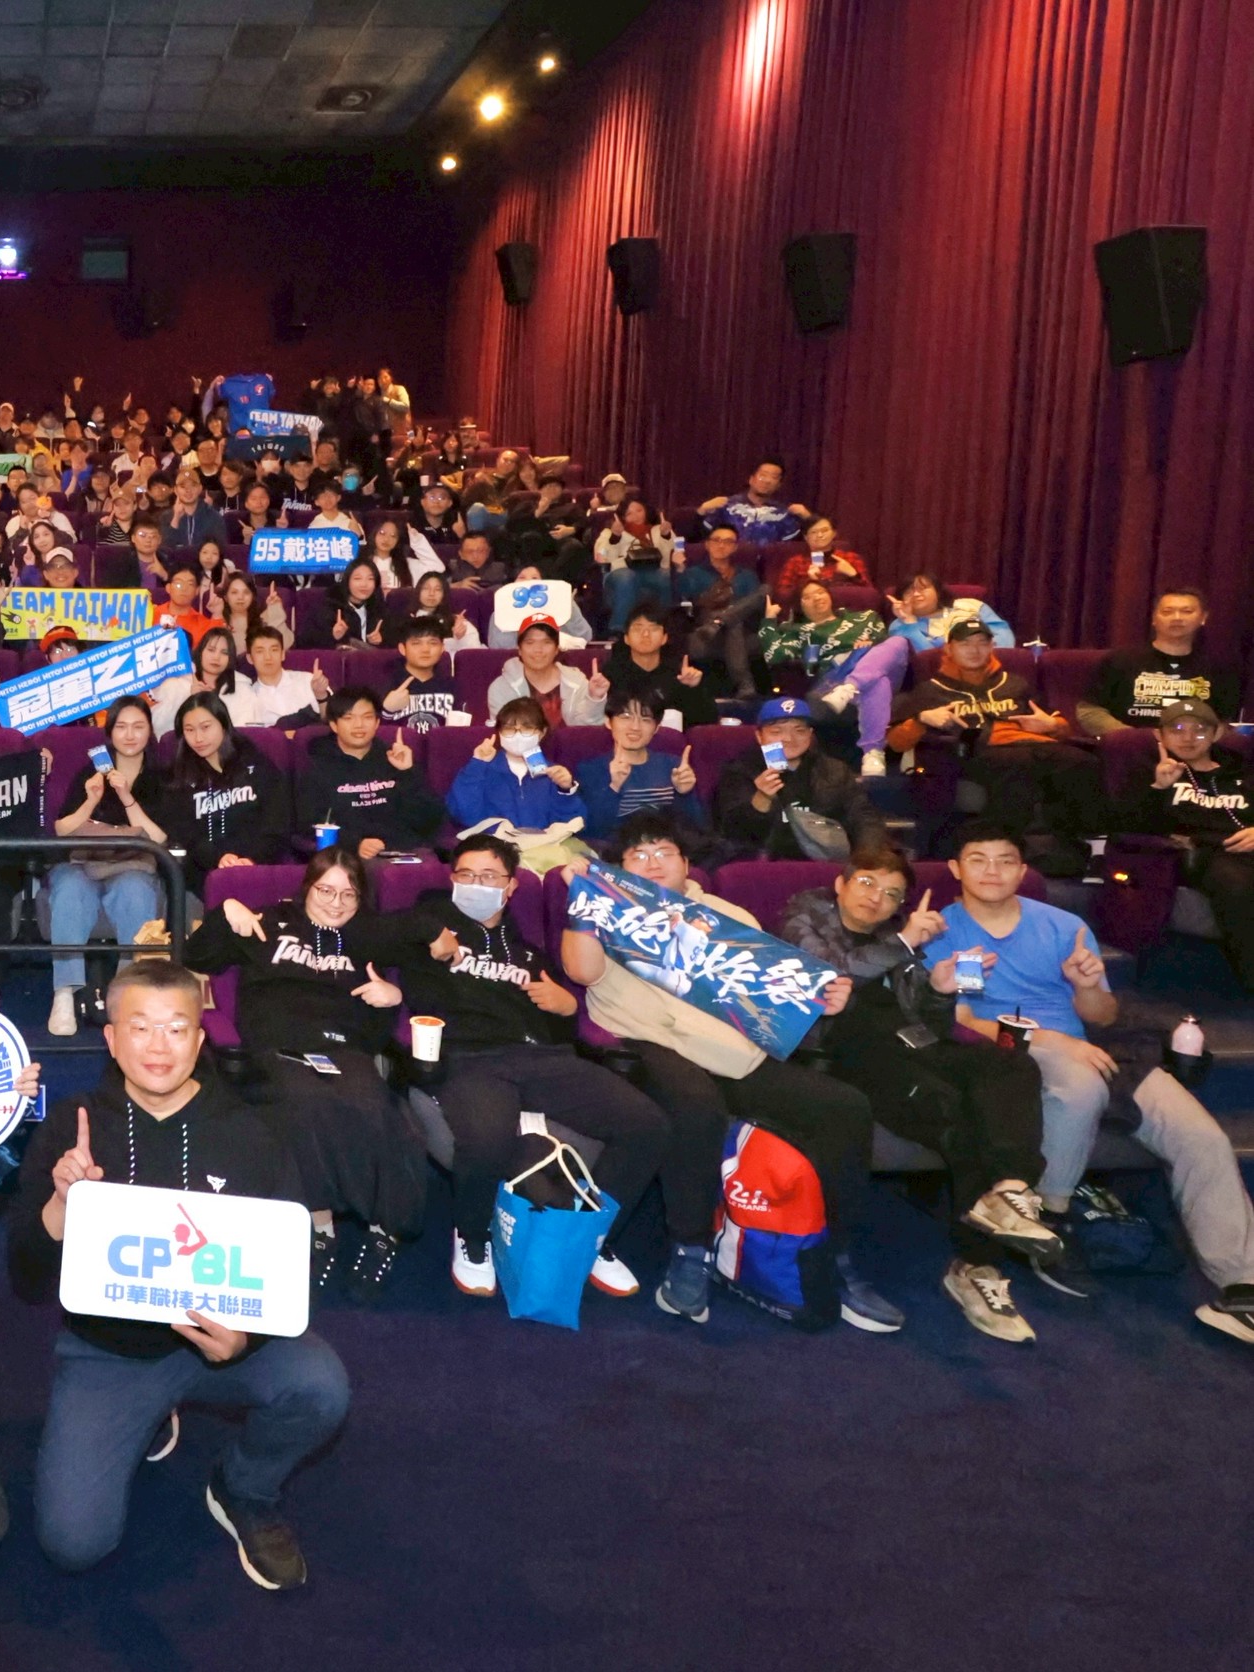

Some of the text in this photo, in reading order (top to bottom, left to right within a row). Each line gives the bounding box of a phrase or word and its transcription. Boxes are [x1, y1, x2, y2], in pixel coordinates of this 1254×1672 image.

[254, 538, 281, 562] 95
[61, 591, 148, 634] TAIWAN
[512, 584, 548, 609] 95
[18, 676, 41, 690] HERO!
[42, 668, 63, 681] HITO!
[63, 659, 86, 672] HERO!
[87, 650, 108, 663] HITO!
[108, 641, 131, 655] HERO!
[133, 633, 153, 645] HITO!
[394, 693, 456, 721] ANKEES
[193, 785, 258, 820] Taiwan
[1172, 782, 1250, 810] Taiwan
[271, 935, 356, 973] Taiwan
[449, 945, 532, 987] Taiwan
[107, 1234, 264, 1291] CPBL
[104, 1282, 264, 1318] 中華職棒大聯盟
